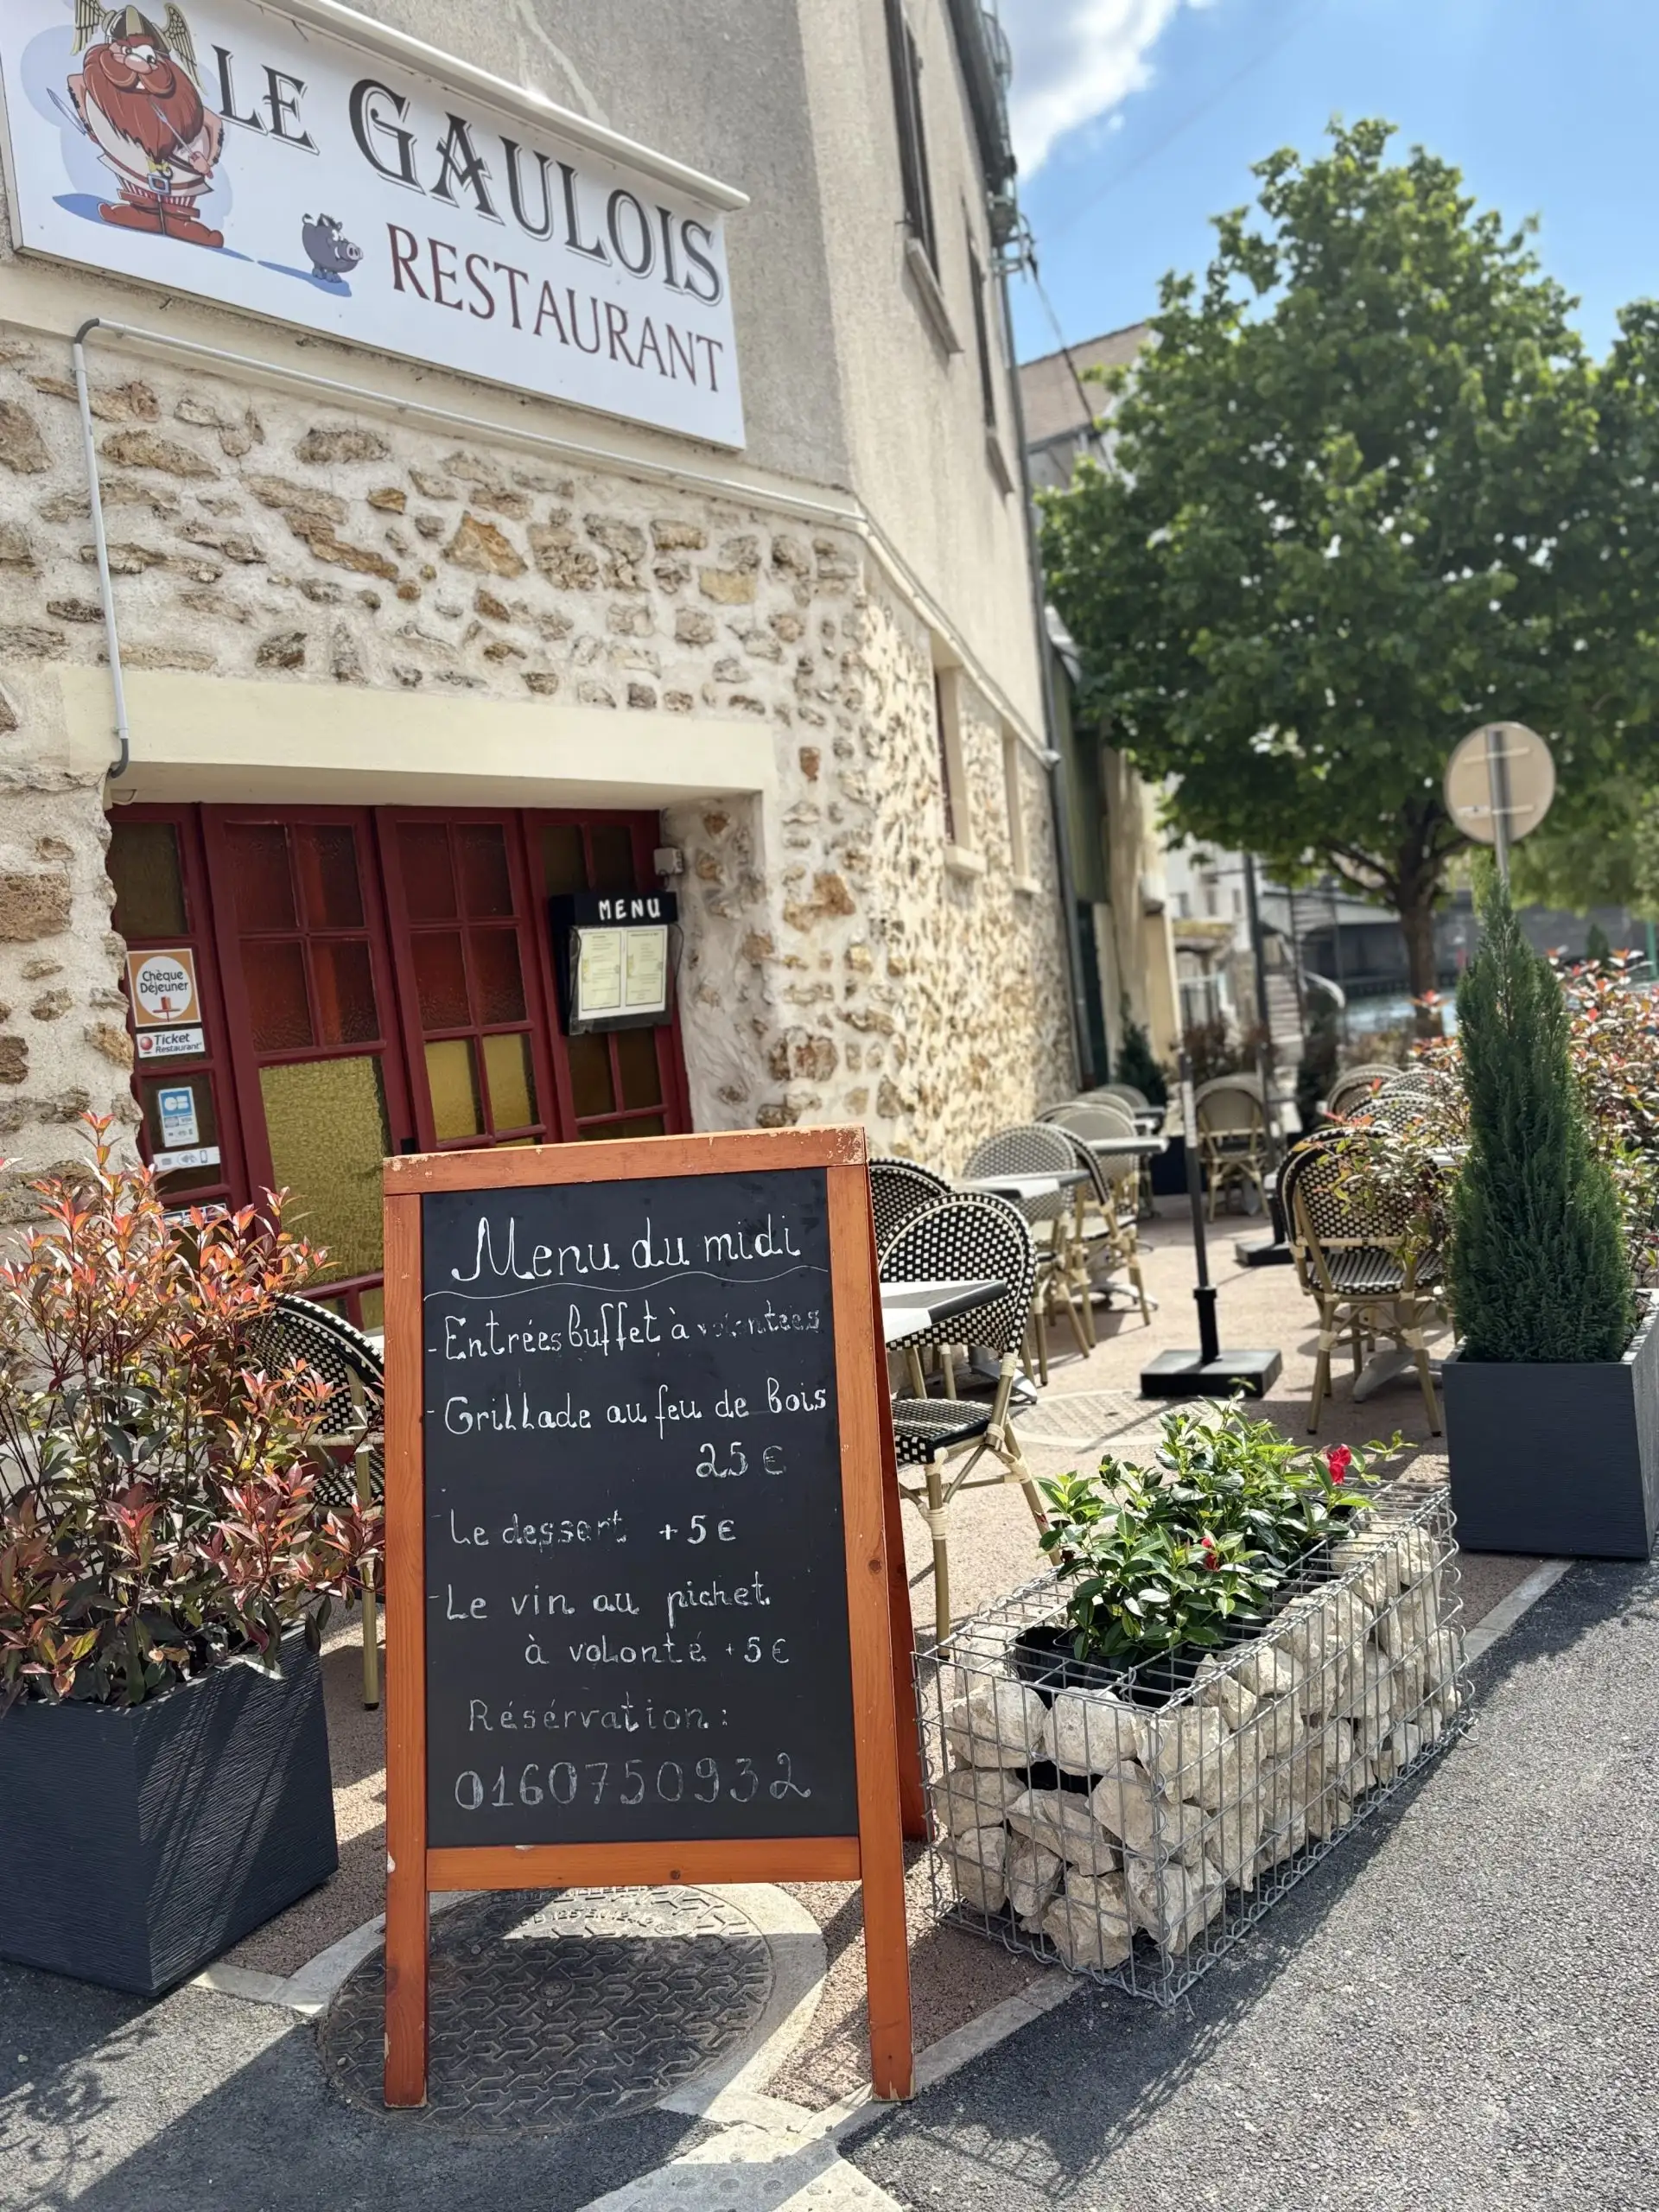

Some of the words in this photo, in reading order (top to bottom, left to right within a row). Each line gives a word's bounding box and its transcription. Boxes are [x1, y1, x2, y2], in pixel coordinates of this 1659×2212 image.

[211, 45, 320, 155] LE
[348, 79, 723, 306] GAULOIS
[386, 223, 723, 392] RESTAURANT
[598, 898, 661, 920] MENU
[140, 981, 188, 995] Déjeuner
[142, 969, 184, 982] Chèque
[154, 1033, 190, 1045] Ticket
[451, 1217, 620, 1281] Menu
[632, 1217, 690, 1268] du
[704, 1213, 801, 1262] midi
[669, 1307, 690, 1339] à
[445, 1392, 591, 1434] Grillade
[607, 1404, 647, 1424] au
[655, 1384, 702, 1440] feu
[715, 1389, 749, 1418] de
[451, 1509, 489, 1545] Le
[503, 1510, 626, 1545] dessert
[447, 1584, 487, 1620] Le
[512, 1585, 575, 1616] vin
[593, 1592, 639, 1615] au
[667, 1571, 770, 1629] pichet
[525, 1634, 550, 1664] à
[569, 1631, 707, 1663] volonté
[455, 1752, 811, 1809] 0160750932
